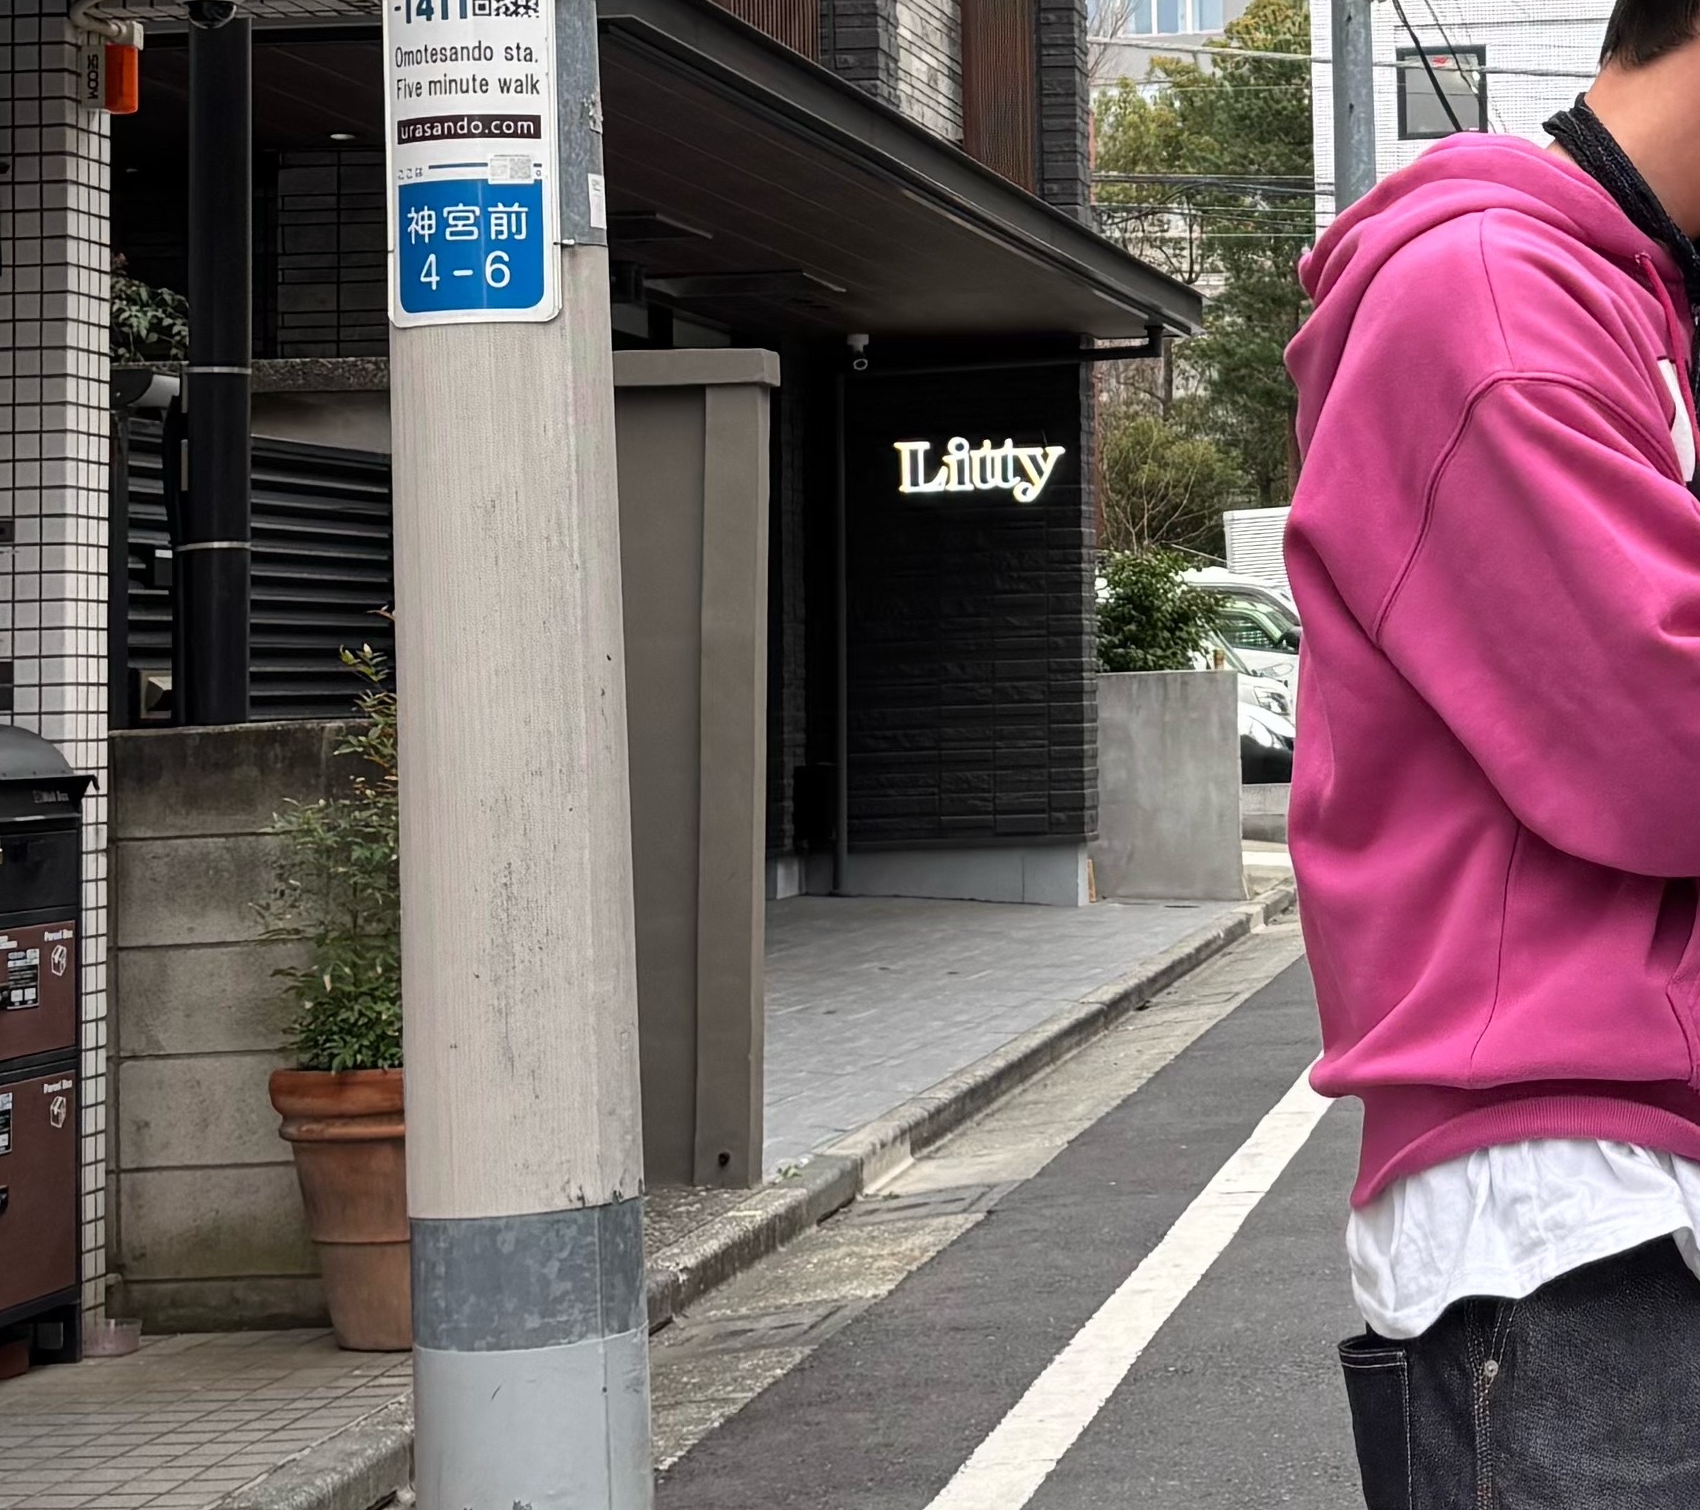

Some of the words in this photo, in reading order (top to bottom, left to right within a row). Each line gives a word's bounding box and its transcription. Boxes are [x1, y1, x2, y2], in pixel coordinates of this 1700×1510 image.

[395, 40, 494, 68] Omotesando
[504, 42, 539, 64] sta.
[396, 78, 423, 100] Five
[428, 73, 490, 96] minute
[498, 73, 541, 96] walk
[401, 116, 535, 140] urasando.com
[406, 201, 529, 245] 神宮前
[419, 249, 512, 291] 4-6
[893, 436, 1067, 503] Litty
